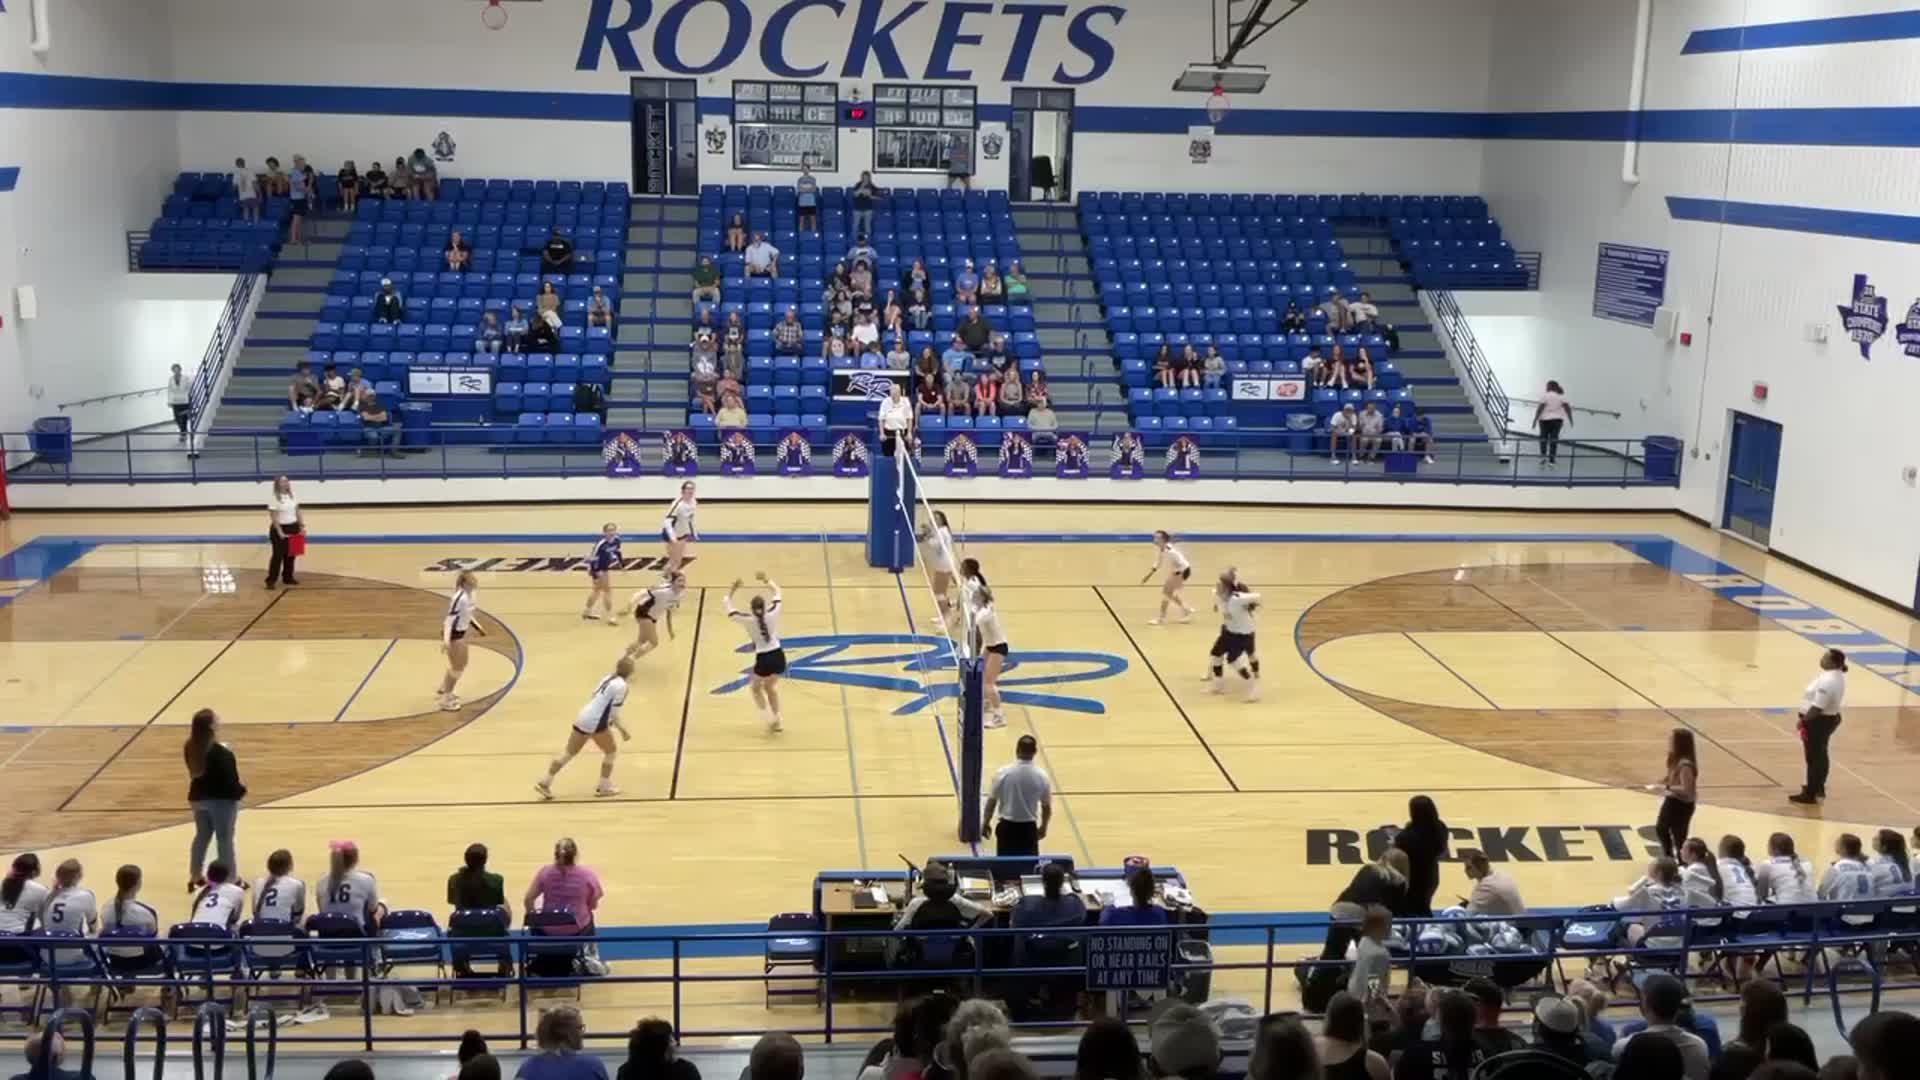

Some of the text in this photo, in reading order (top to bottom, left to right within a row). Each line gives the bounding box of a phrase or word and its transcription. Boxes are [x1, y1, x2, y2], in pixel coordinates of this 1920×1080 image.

[576, 0, 1127, 85] ROCKETS
[205, 893, 219, 908] 3
[265, 887, 279, 907] 2
[52, 903, 66, 923] 5
[1090, 935, 1168, 952] NO STANDING ON
[1091, 952, 1167, 968] OR NEAR RAILS
[1096, 969, 1161, 985] AT ANY TIME
